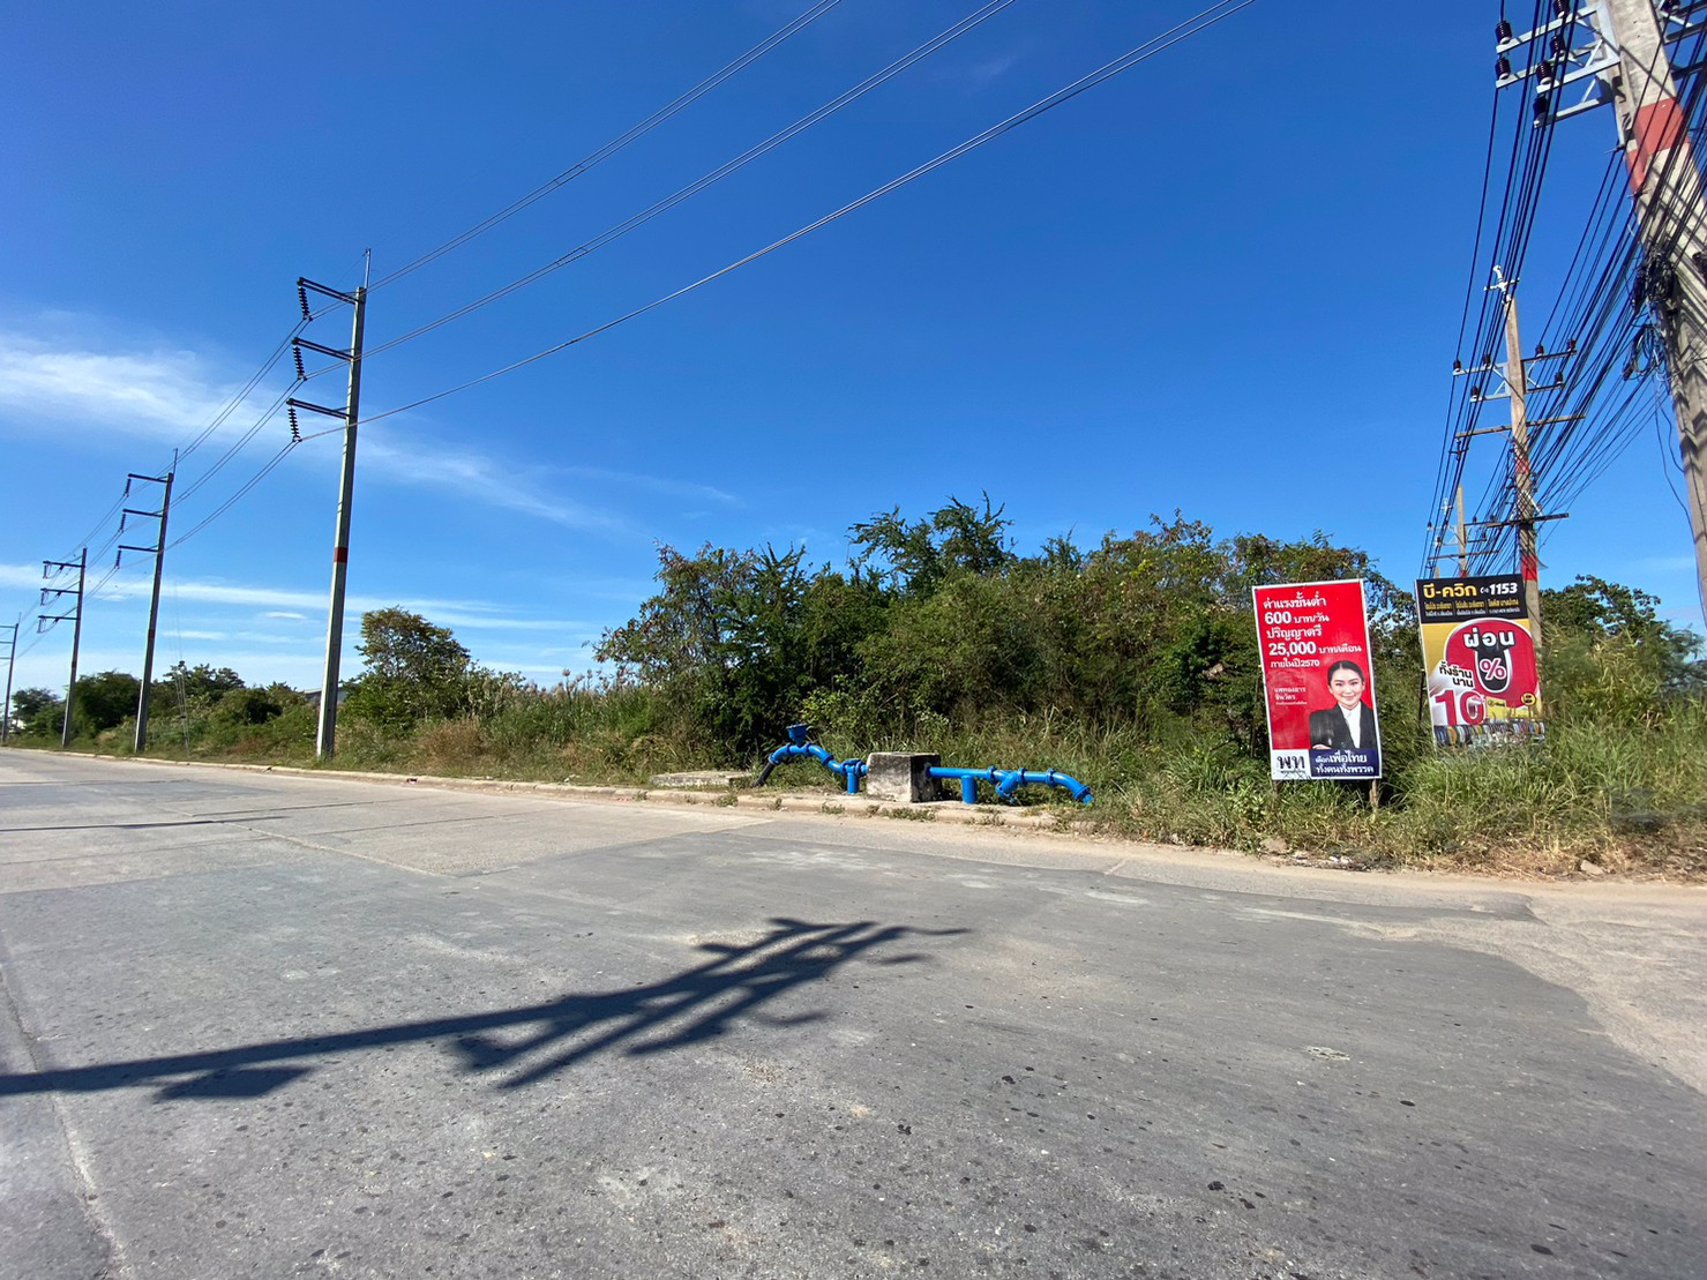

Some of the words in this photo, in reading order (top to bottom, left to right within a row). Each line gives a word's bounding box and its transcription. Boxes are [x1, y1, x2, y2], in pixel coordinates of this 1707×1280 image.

[1423, 583, 1477, 599] บี-ควิก
[1489, 582, 1518, 596] 1153
[1264, 612, 1292, 625] 600
[1266, 624, 1323, 640] ปริญญาตรี
[1463, 627, 1515, 648] ผ่อน
[1268, 641, 1317, 657] 25,000
[1439, 661, 1473, 679] ทั้งร้าน
[1452, 677, 1474, 688] นาน
[1435, 689, 1485, 726] 10
